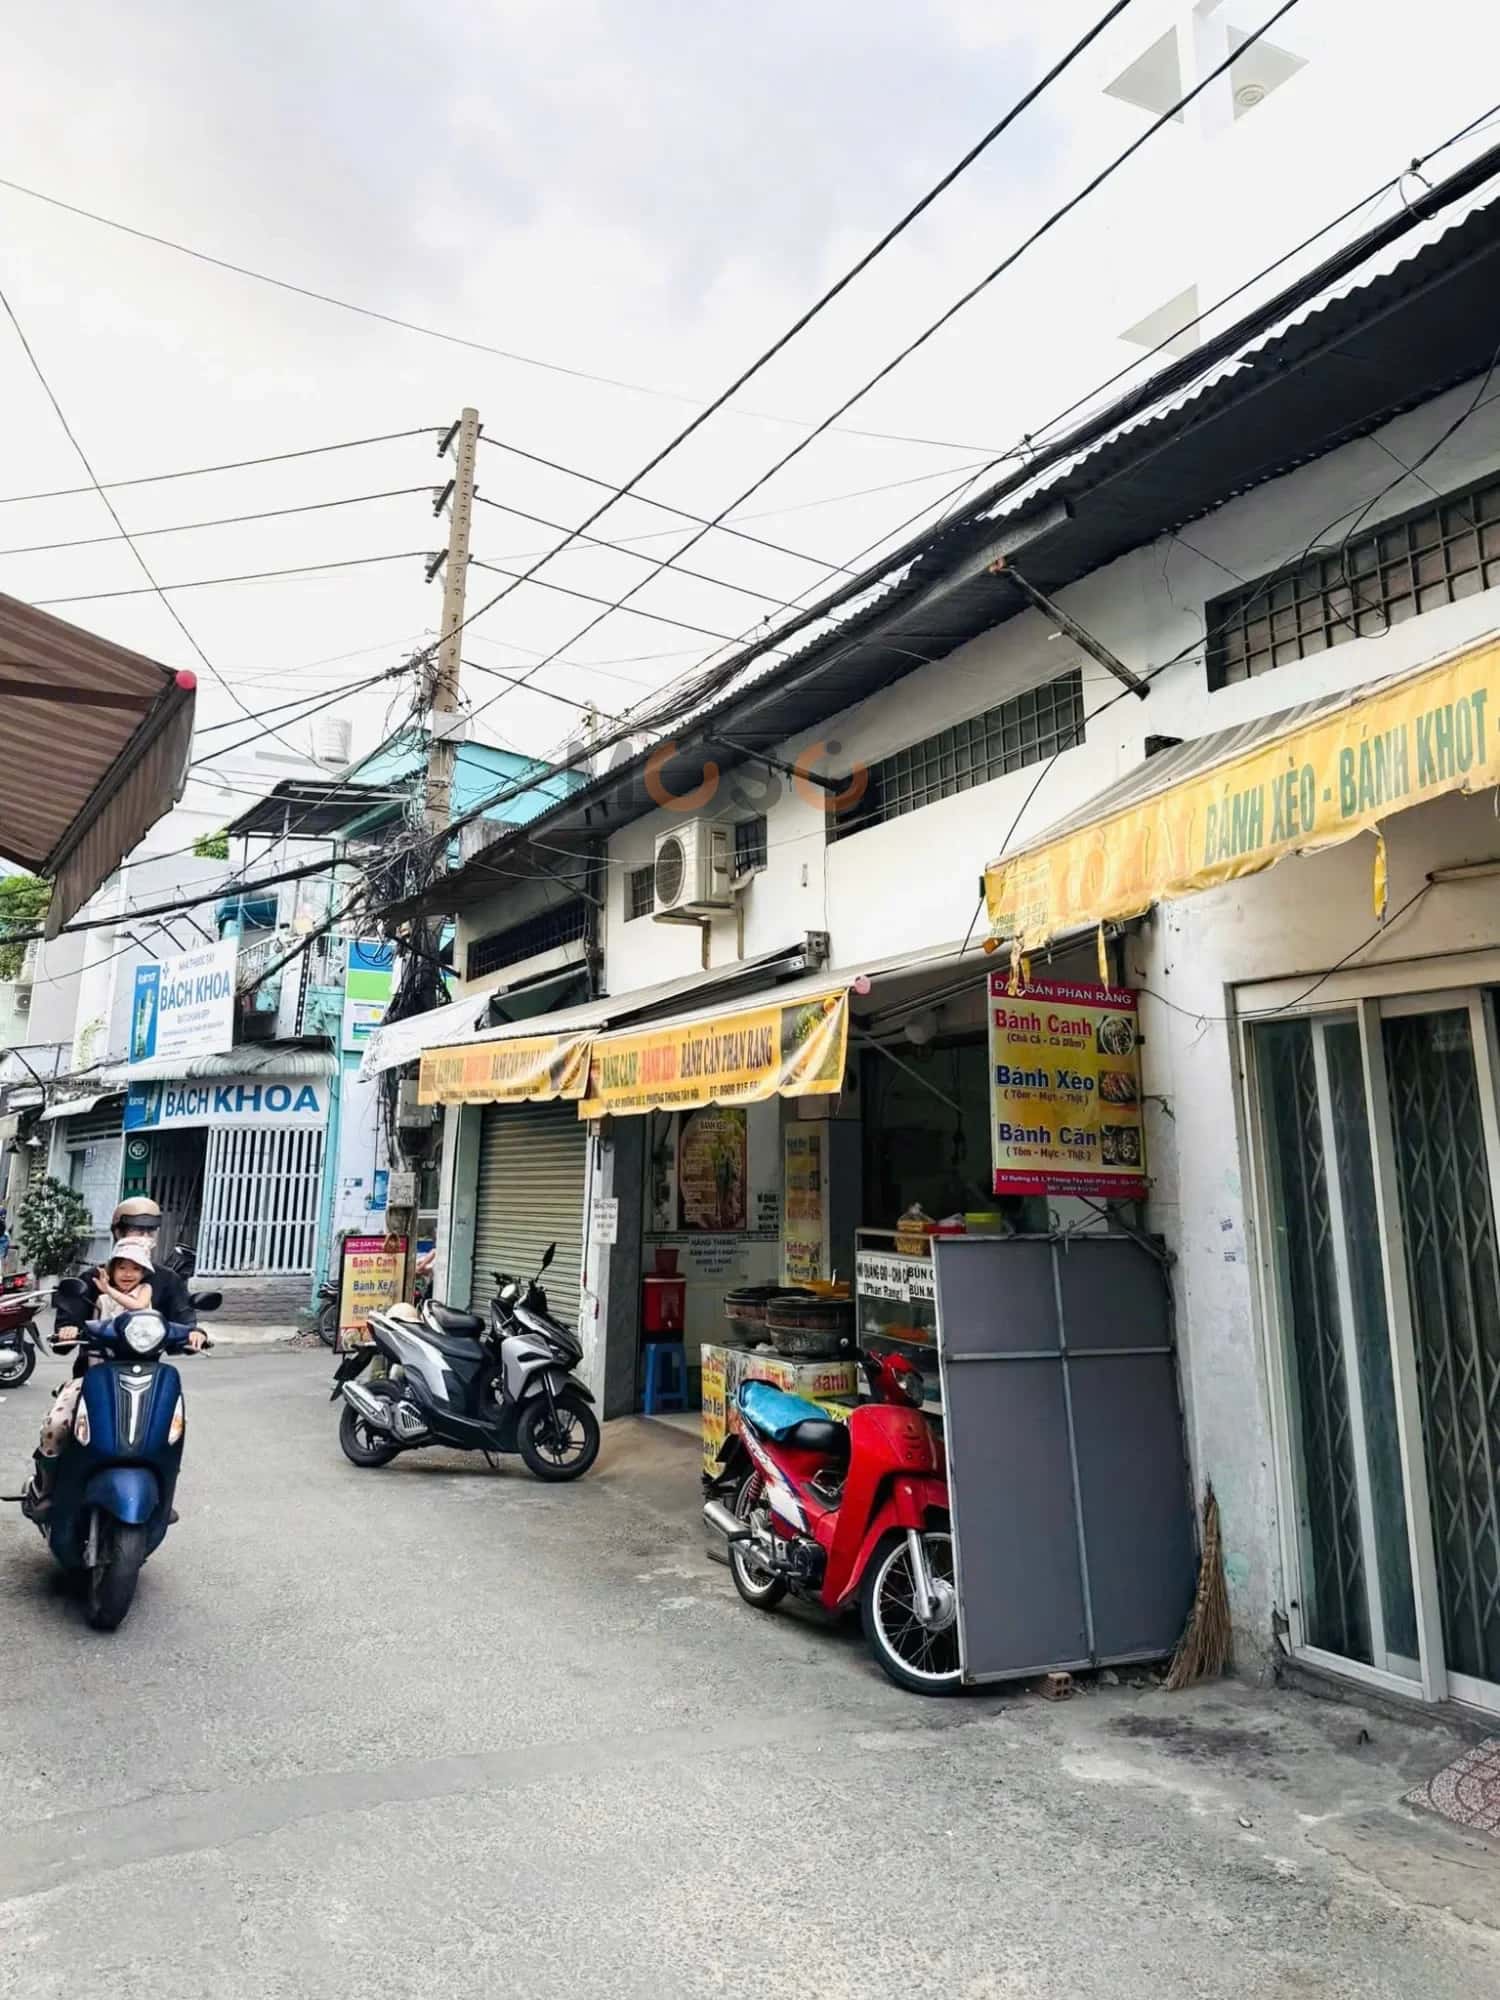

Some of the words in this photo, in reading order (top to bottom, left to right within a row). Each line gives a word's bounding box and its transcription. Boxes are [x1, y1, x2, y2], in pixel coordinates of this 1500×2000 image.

[1205, 782, 1264, 865] BÁNH
[1270, 755, 1316, 844] XÈO
[1338, 724, 1410, 820] BÁNH
[159, 976, 193, 1012] BÁCH
[195, 969, 231, 1004] KHOA
[1057, 988, 1092, 999] PHAN
[1096, 990, 1132, 1005] RANG
[995, 1009, 1041, 1032] Bánh
[1048, 1013, 1092, 1037] Canh
[996, 1064, 1049, 1087] Bánh
[1056, 1069, 1095, 1090] Xèo
[165, 1084, 209, 1117] BÁCH
[213, 1085, 320, 1112] KHOA
[999, 1122, 1051, 1144] Bánh
